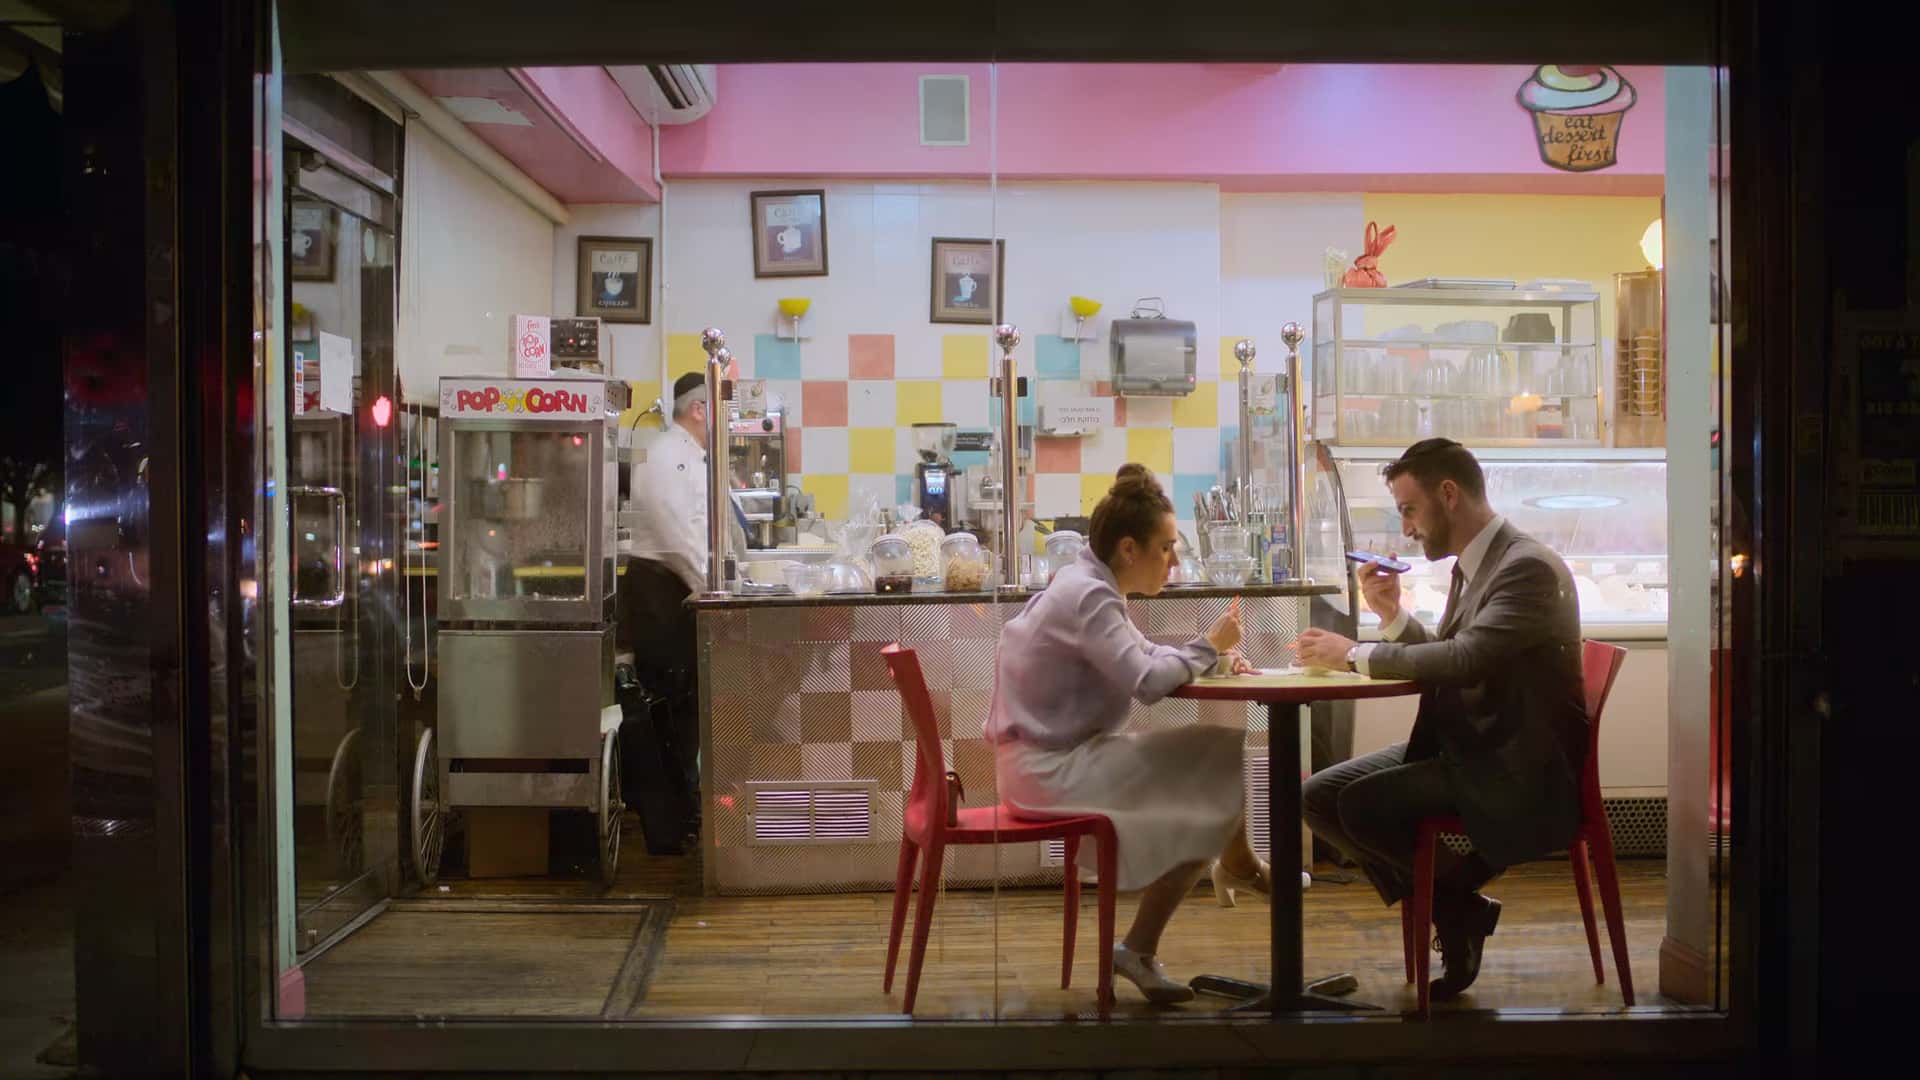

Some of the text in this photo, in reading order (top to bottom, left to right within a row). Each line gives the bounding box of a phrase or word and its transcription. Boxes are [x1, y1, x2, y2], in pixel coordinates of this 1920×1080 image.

[1564, 116, 1594, 128] eat
[1543, 125, 1606, 144] dessert
[1567, 144, 1611, 166] first
[522, 334, 540, 348] POP
[524, 344, 545, 358] CORN
[457, 387, 588, 413] POP CORN
